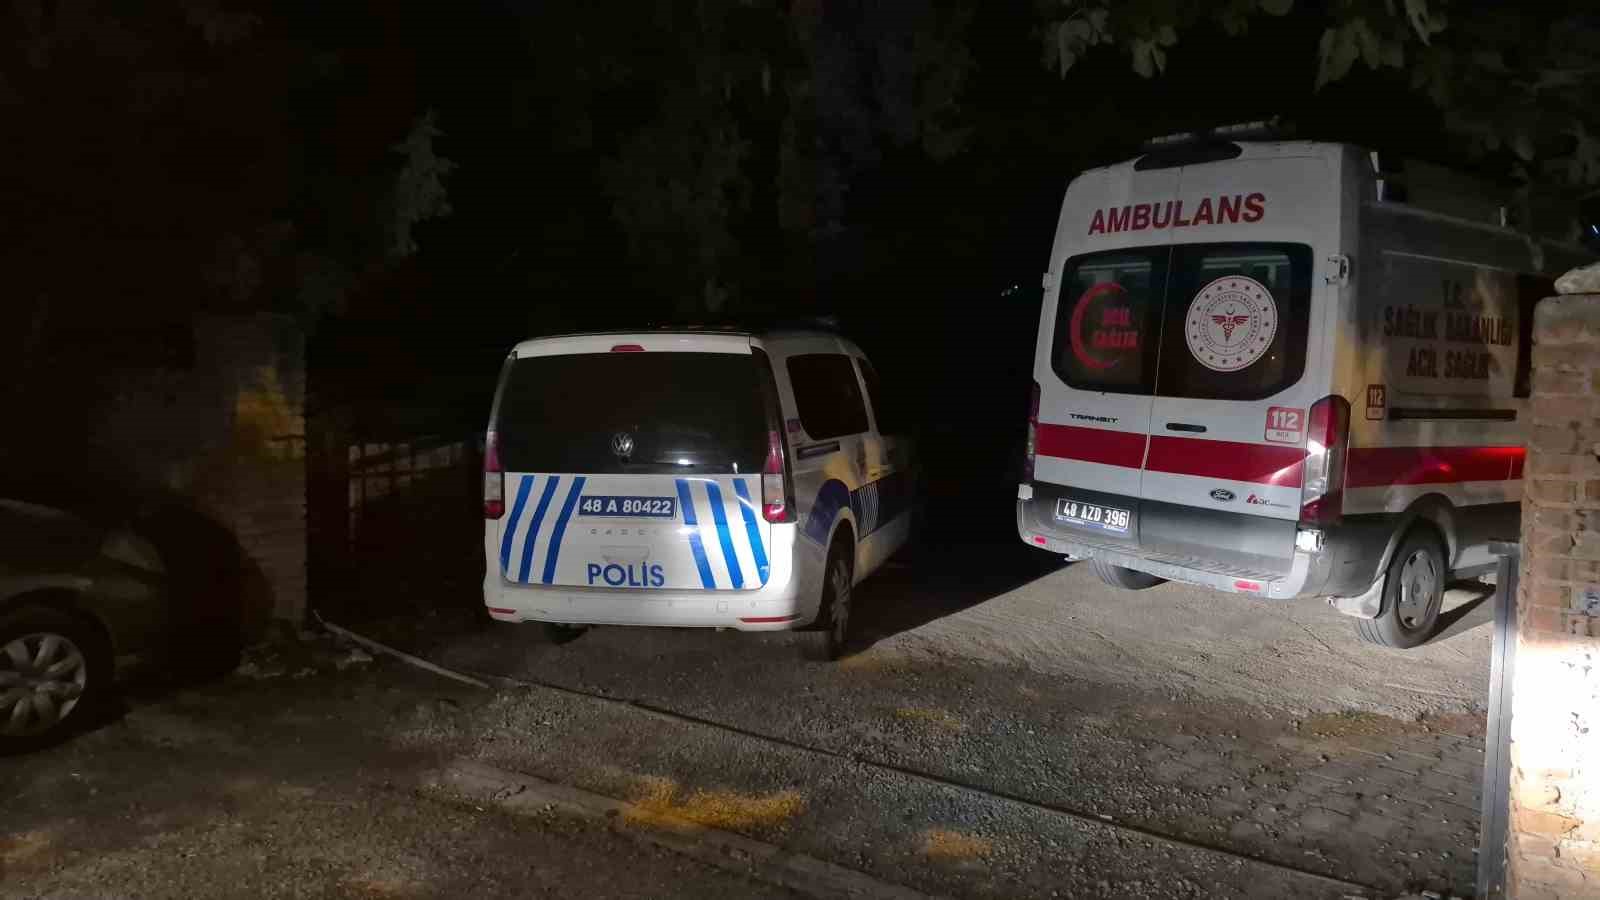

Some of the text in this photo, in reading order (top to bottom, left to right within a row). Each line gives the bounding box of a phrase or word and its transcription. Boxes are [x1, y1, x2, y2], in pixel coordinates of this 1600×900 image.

[1088, 192, 1266, 235] AMBULANS
[1369, 388, 1385, 406] 112
[1069, 412, 1119, 424] TRANSIT
[1271, 410, 1299, 430] 112
[582, 498, 672, 514] 48 A 80422
[1063, 502, 1127, 527] 48 AZD 396
[587, 561, 665, 587] POLİS
